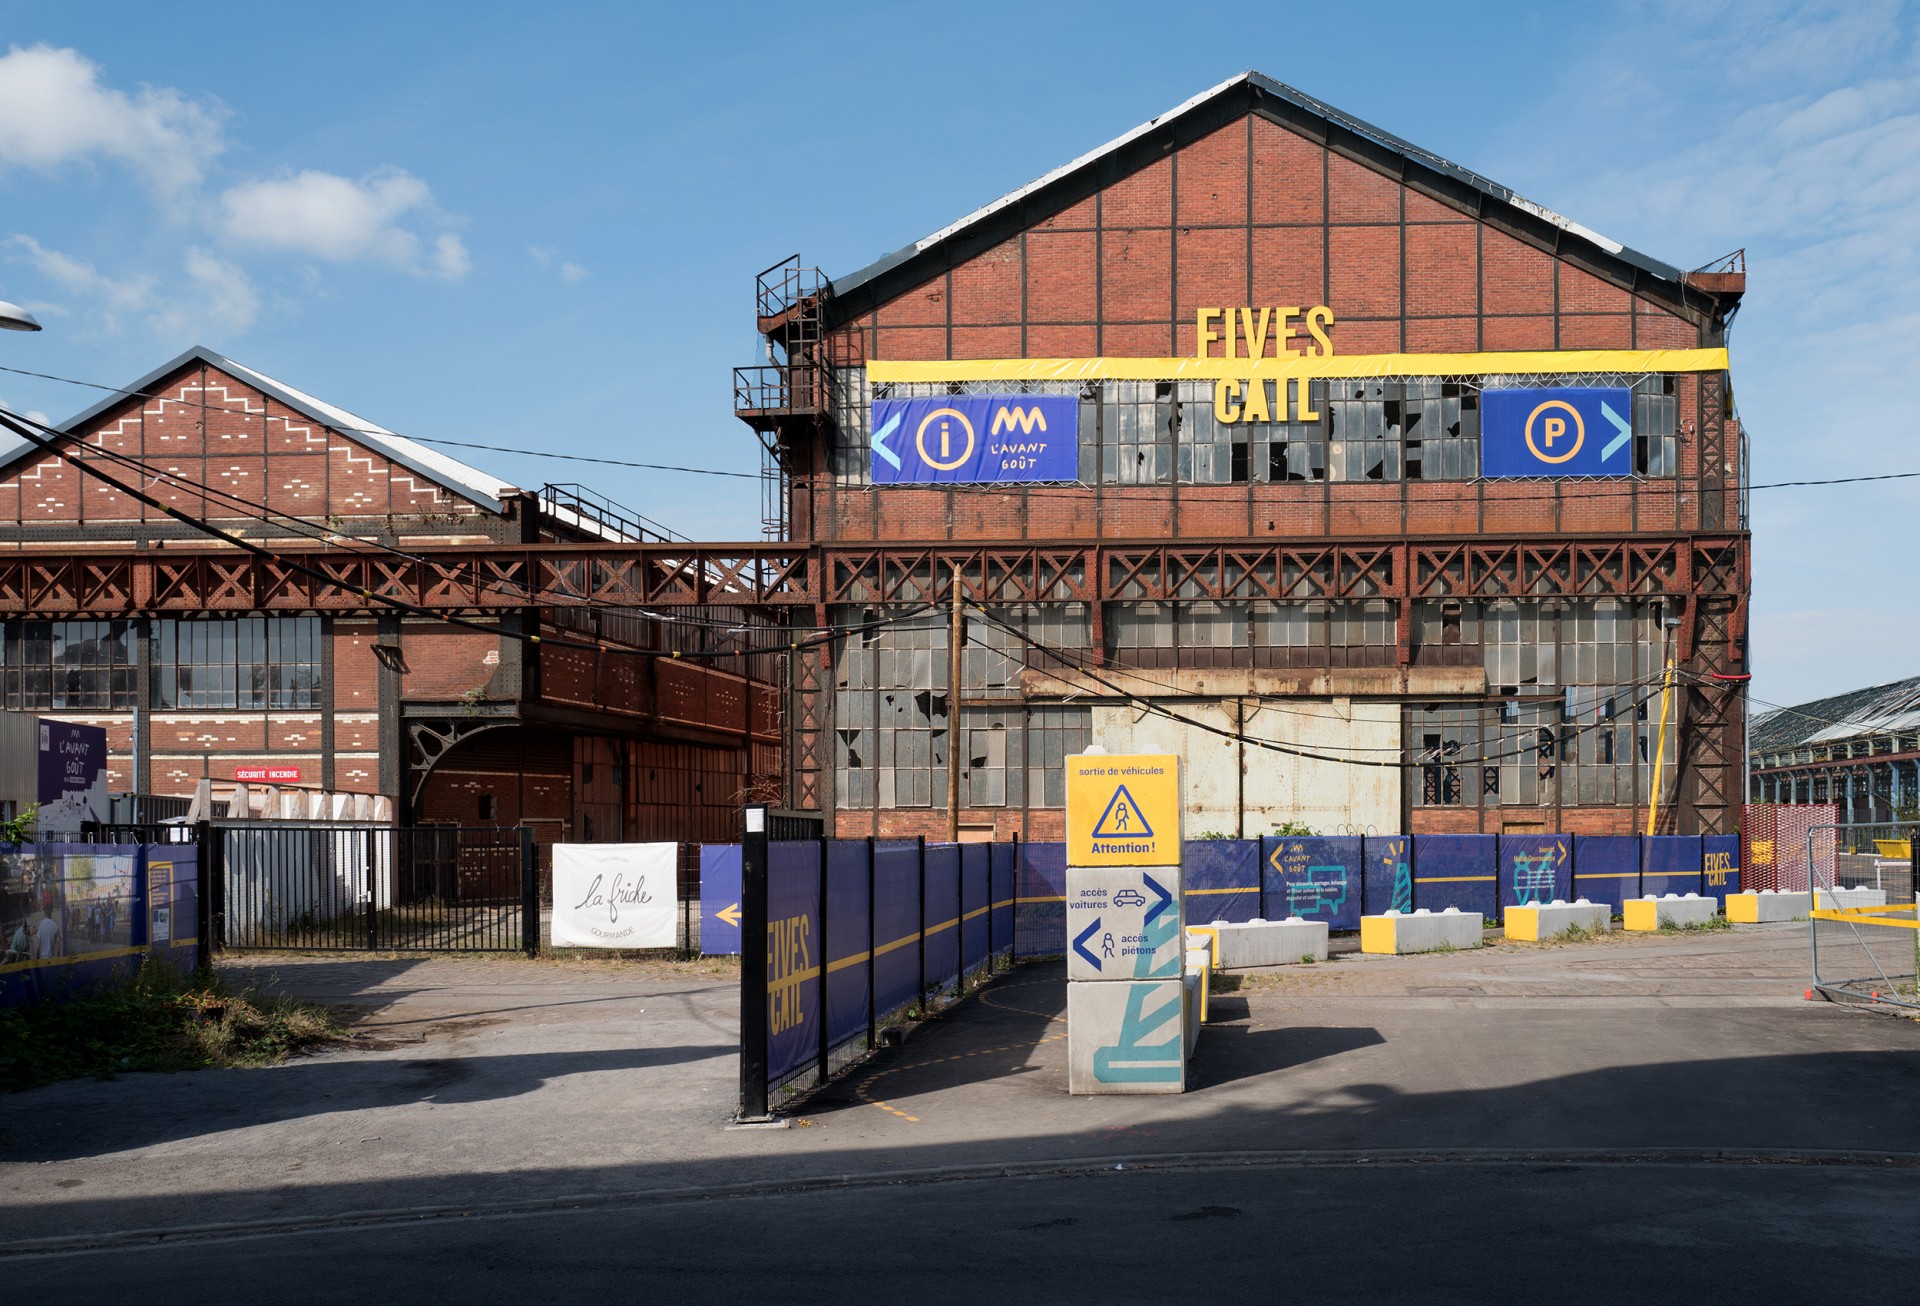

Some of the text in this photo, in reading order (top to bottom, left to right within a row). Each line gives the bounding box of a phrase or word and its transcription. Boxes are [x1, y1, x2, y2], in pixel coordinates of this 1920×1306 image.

[1197, 306, 1334, 358] FIVES
[1214, 378, 1319, 423] CAIL
[1545, 418, 1566, 447] P
[991, 443, 1047, 454] L'AVANT
[1002, 456, 1036, 470] GOÛT
[60, 740, 90, 756] L'AVANT
[66, 756, 85, 775] GOÛT
[1079, 766, 1164, 776] sortie de véhicules
[237, 770, 298, 779] SÉCURITÉ INCENDIE
[1704, 852, 1730, 871] FIVES
[1708, 872, 1727, 887] CAIL
[574, 872, 653, 924] la friche
[1080, 888, 1107, 897] accès
[1069, 901, 1108, 910] voitures
[591, 926, 635, 940] GOURMANDE
[1121, 933, 1148, 943] accès
[767, 914, 809, 980] FIVES
[1121, 946, 1156, 957] piétons
[770, 982, 804, 1036] CAIL
